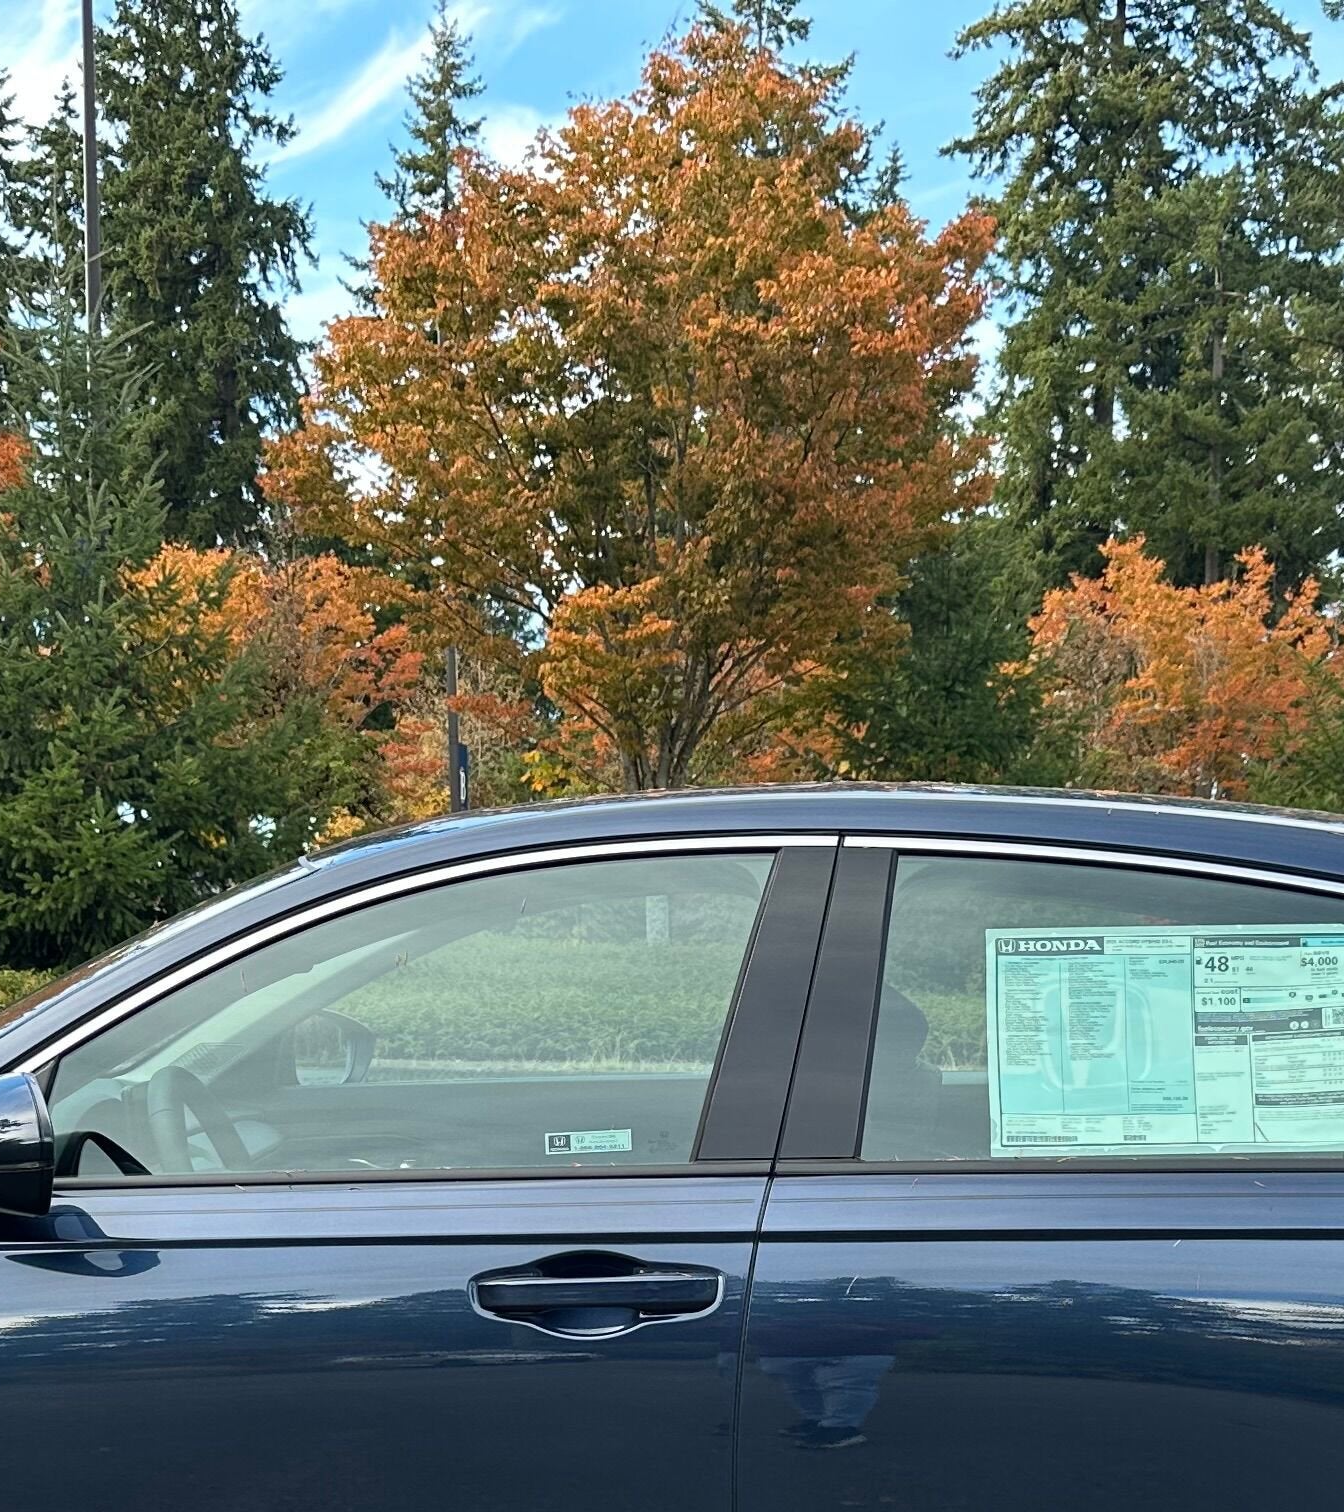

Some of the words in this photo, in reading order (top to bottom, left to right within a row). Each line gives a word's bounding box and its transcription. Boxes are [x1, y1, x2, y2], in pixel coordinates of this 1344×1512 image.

[1018, 939, 1102, 952] HONDA
[1204, 956, 1229, 972] 48
[1301, 956, 1338, 967] $4,000
